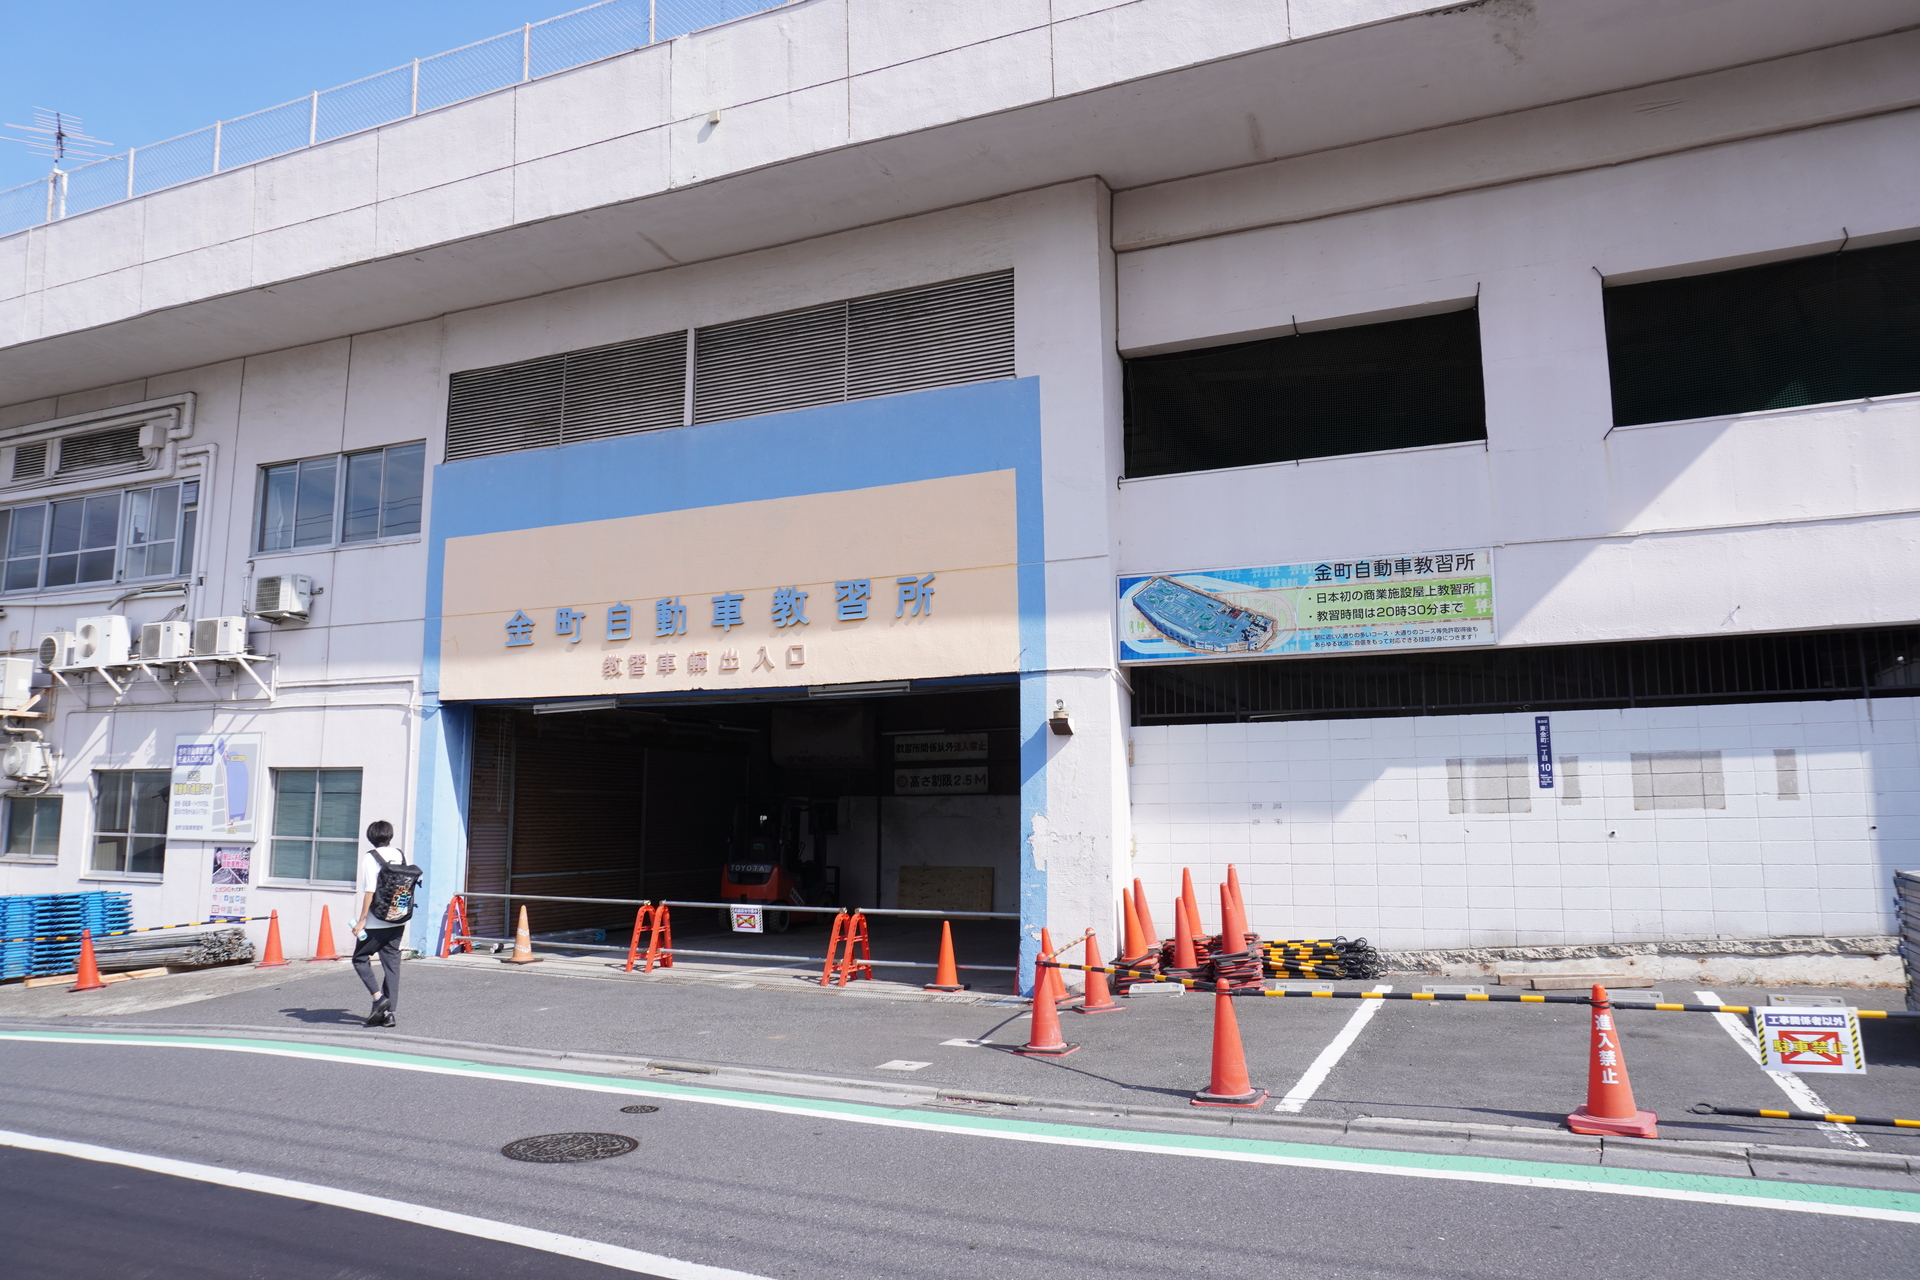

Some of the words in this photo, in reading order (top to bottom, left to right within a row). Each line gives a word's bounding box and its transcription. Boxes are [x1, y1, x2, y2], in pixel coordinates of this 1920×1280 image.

[1314, 553, 1476, 582] 金町自動車教習所
[504, 573, 939, 650] 金町自動車教習所
[895, 740, 988, 755] 教習所関係以外進入禁止
[1540, 763, 1551, 772] 10
[730, 864, 765, 873] TOYOTA
[1767, 1015, 1845, 1028] 工事関係者以外
[1594, 1014, 1620, 1085] 進入禁止
[1772, 1038, 1851, 1056] 駐車禁止
